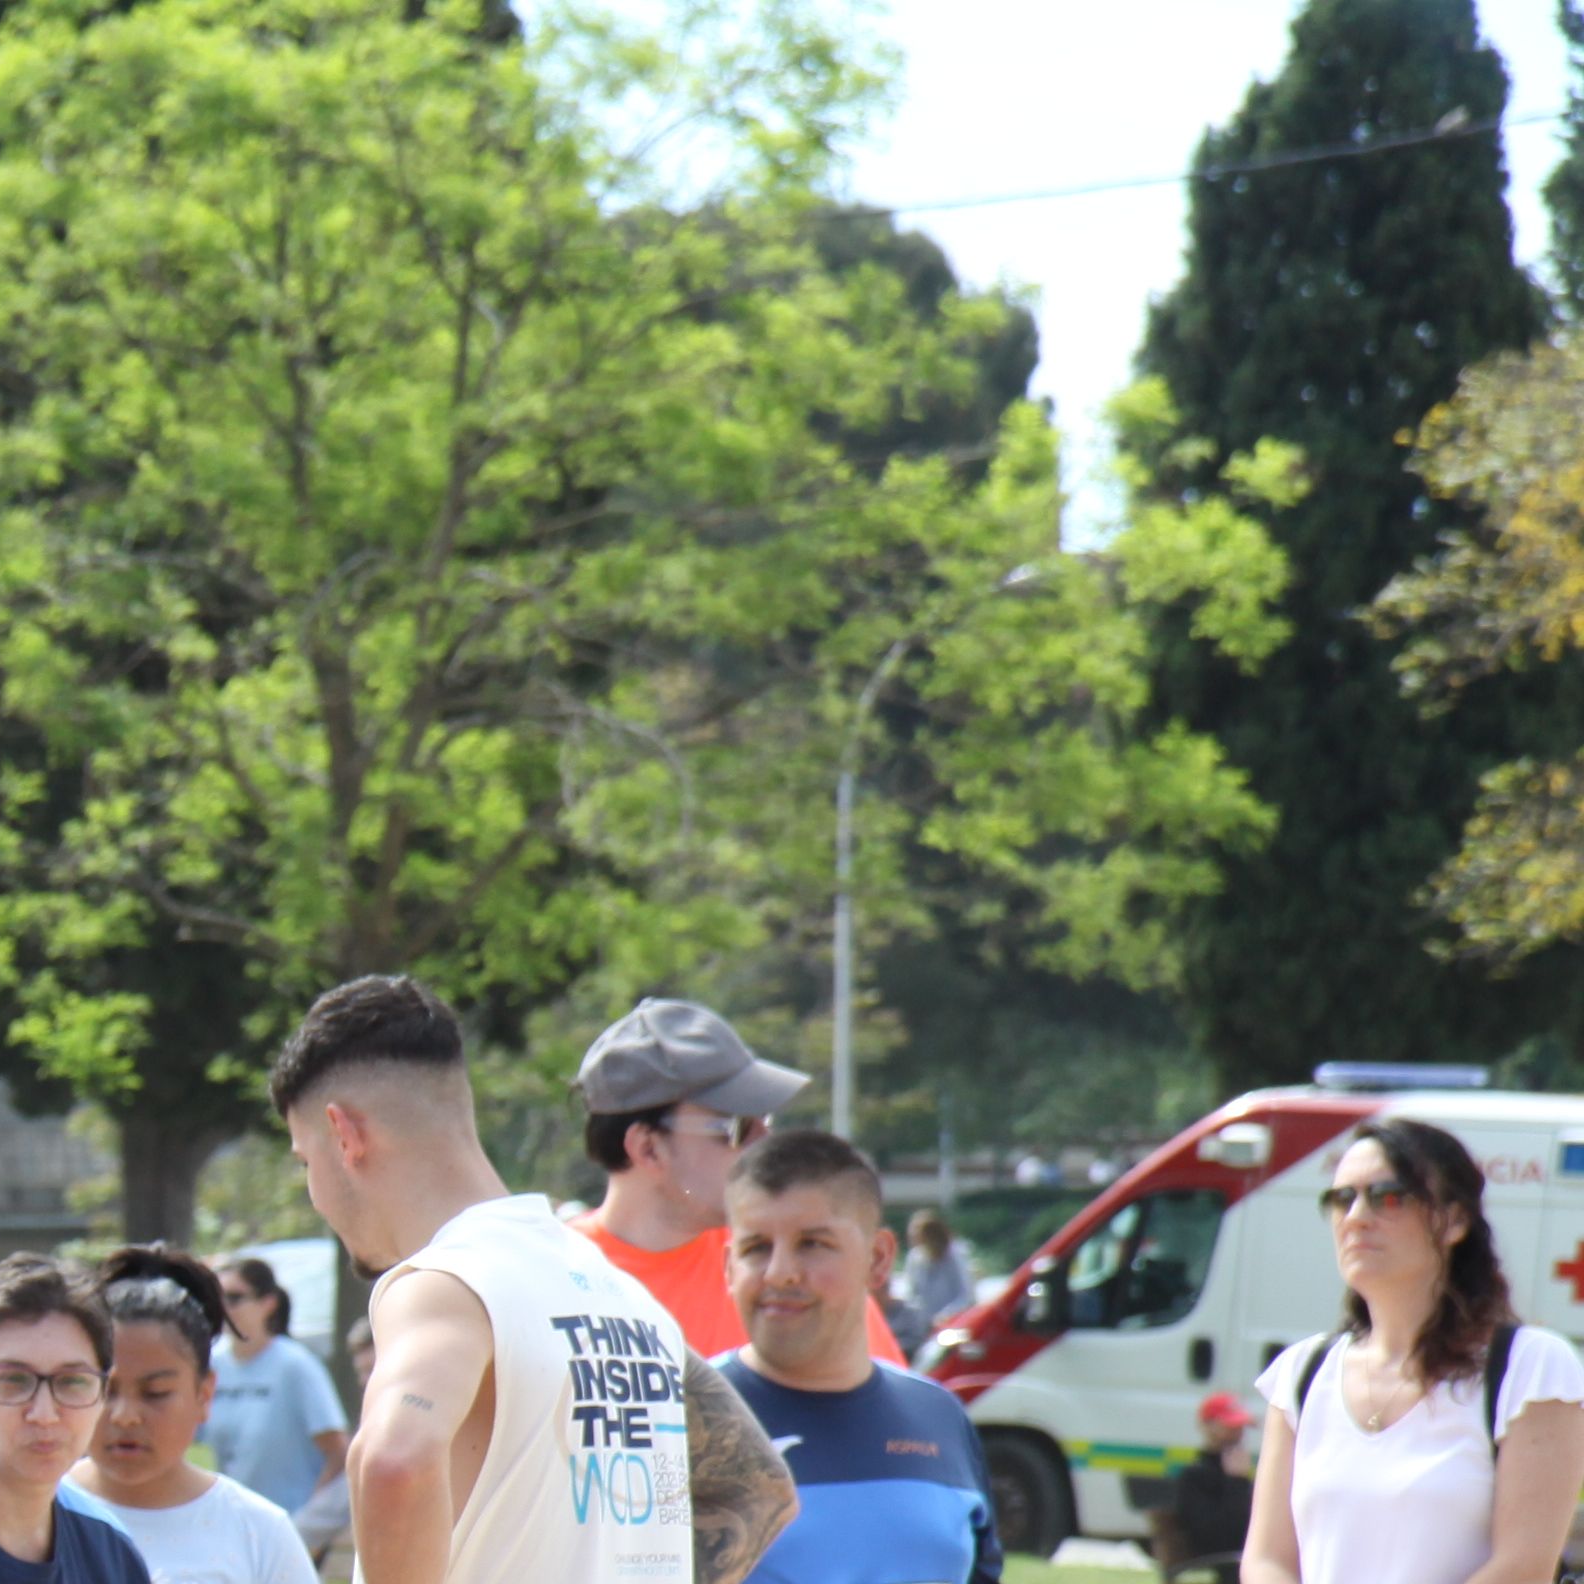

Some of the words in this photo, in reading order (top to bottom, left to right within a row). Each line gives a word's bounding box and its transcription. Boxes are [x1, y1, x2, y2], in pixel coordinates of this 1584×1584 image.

[551, 1314, 676, 1364] THINK
[567, 1358, 685, 1404] INSIDE
[572, 1406, 653, 1448] THE
